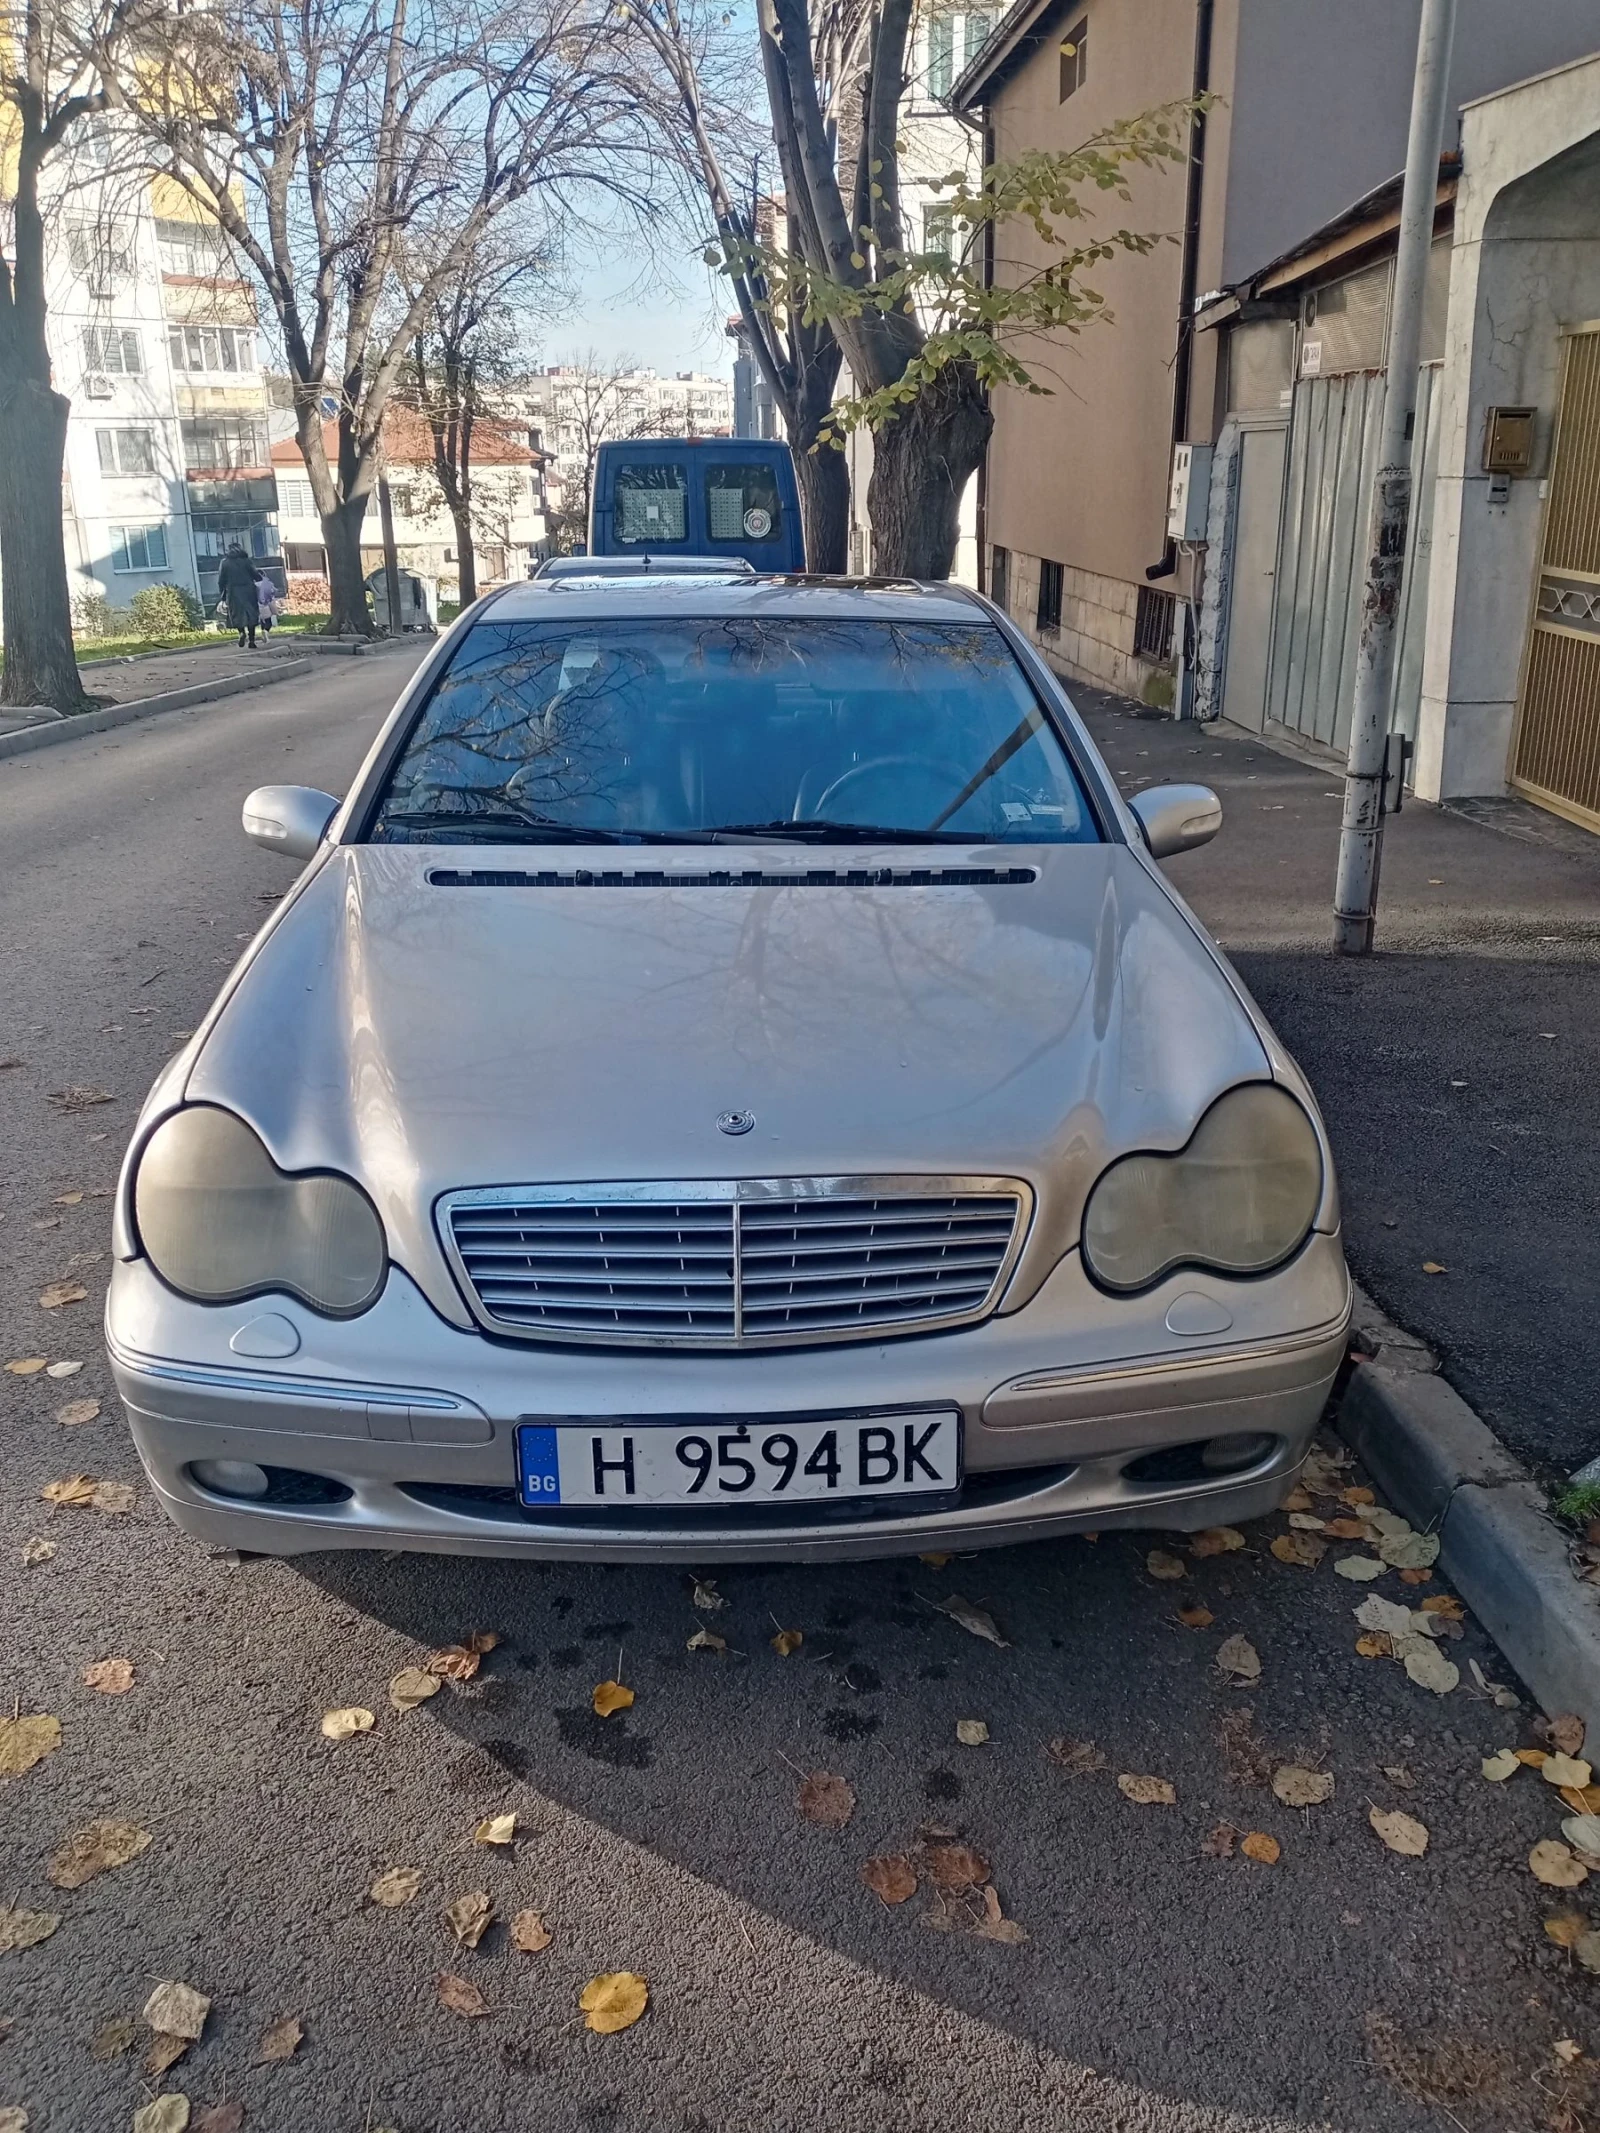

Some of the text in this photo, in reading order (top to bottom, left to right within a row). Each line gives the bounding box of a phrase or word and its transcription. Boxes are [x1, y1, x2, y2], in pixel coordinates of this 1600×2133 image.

[591, 1422, 943, 1495] H 9594 BK
[528, 1474, 556, 1492] BG
